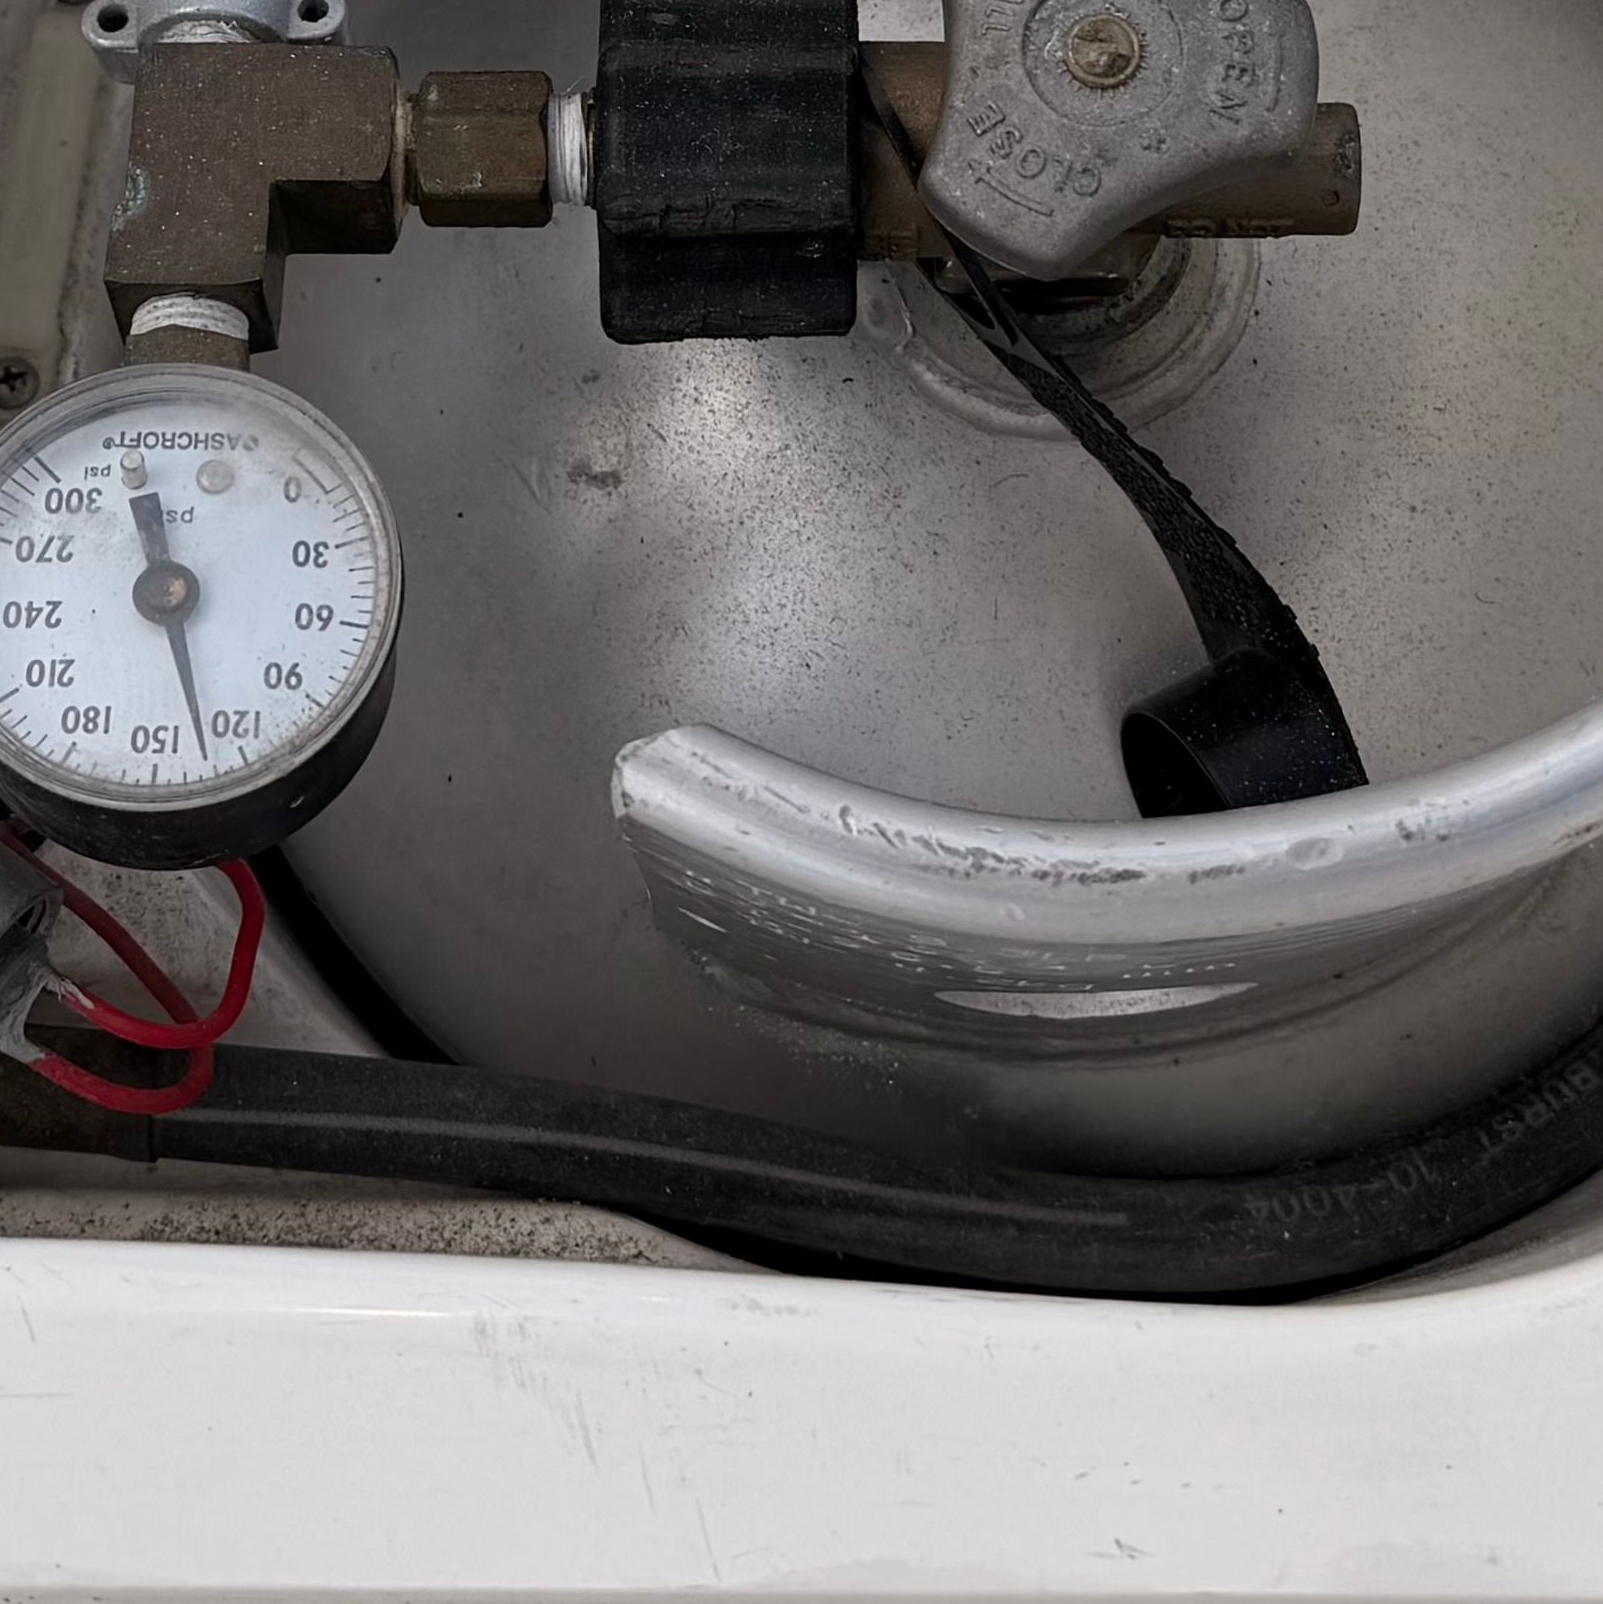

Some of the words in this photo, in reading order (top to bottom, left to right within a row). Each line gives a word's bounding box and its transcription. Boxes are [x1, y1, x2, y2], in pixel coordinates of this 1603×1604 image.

[83, 463, 112, 482] psi
[43, 486, 104, 515] 300
[283, 475, 303, 504] 0
[162, 505, 195, 525] ps
[14, 534, 74, 564] 270
[291, 540, 330, 569] 30
[1, 600, 64, 630] 240
[294, 602, 335, 632] 60
[25, 658, 76, 688] 210
[263, 662, 304, 691] 90
[60, 705, 112, 735] 180
[211, 709, 262, 739] 120
[130, 724, 180, 755] 150
[1476, 1061, 1601, 1161] BURST
